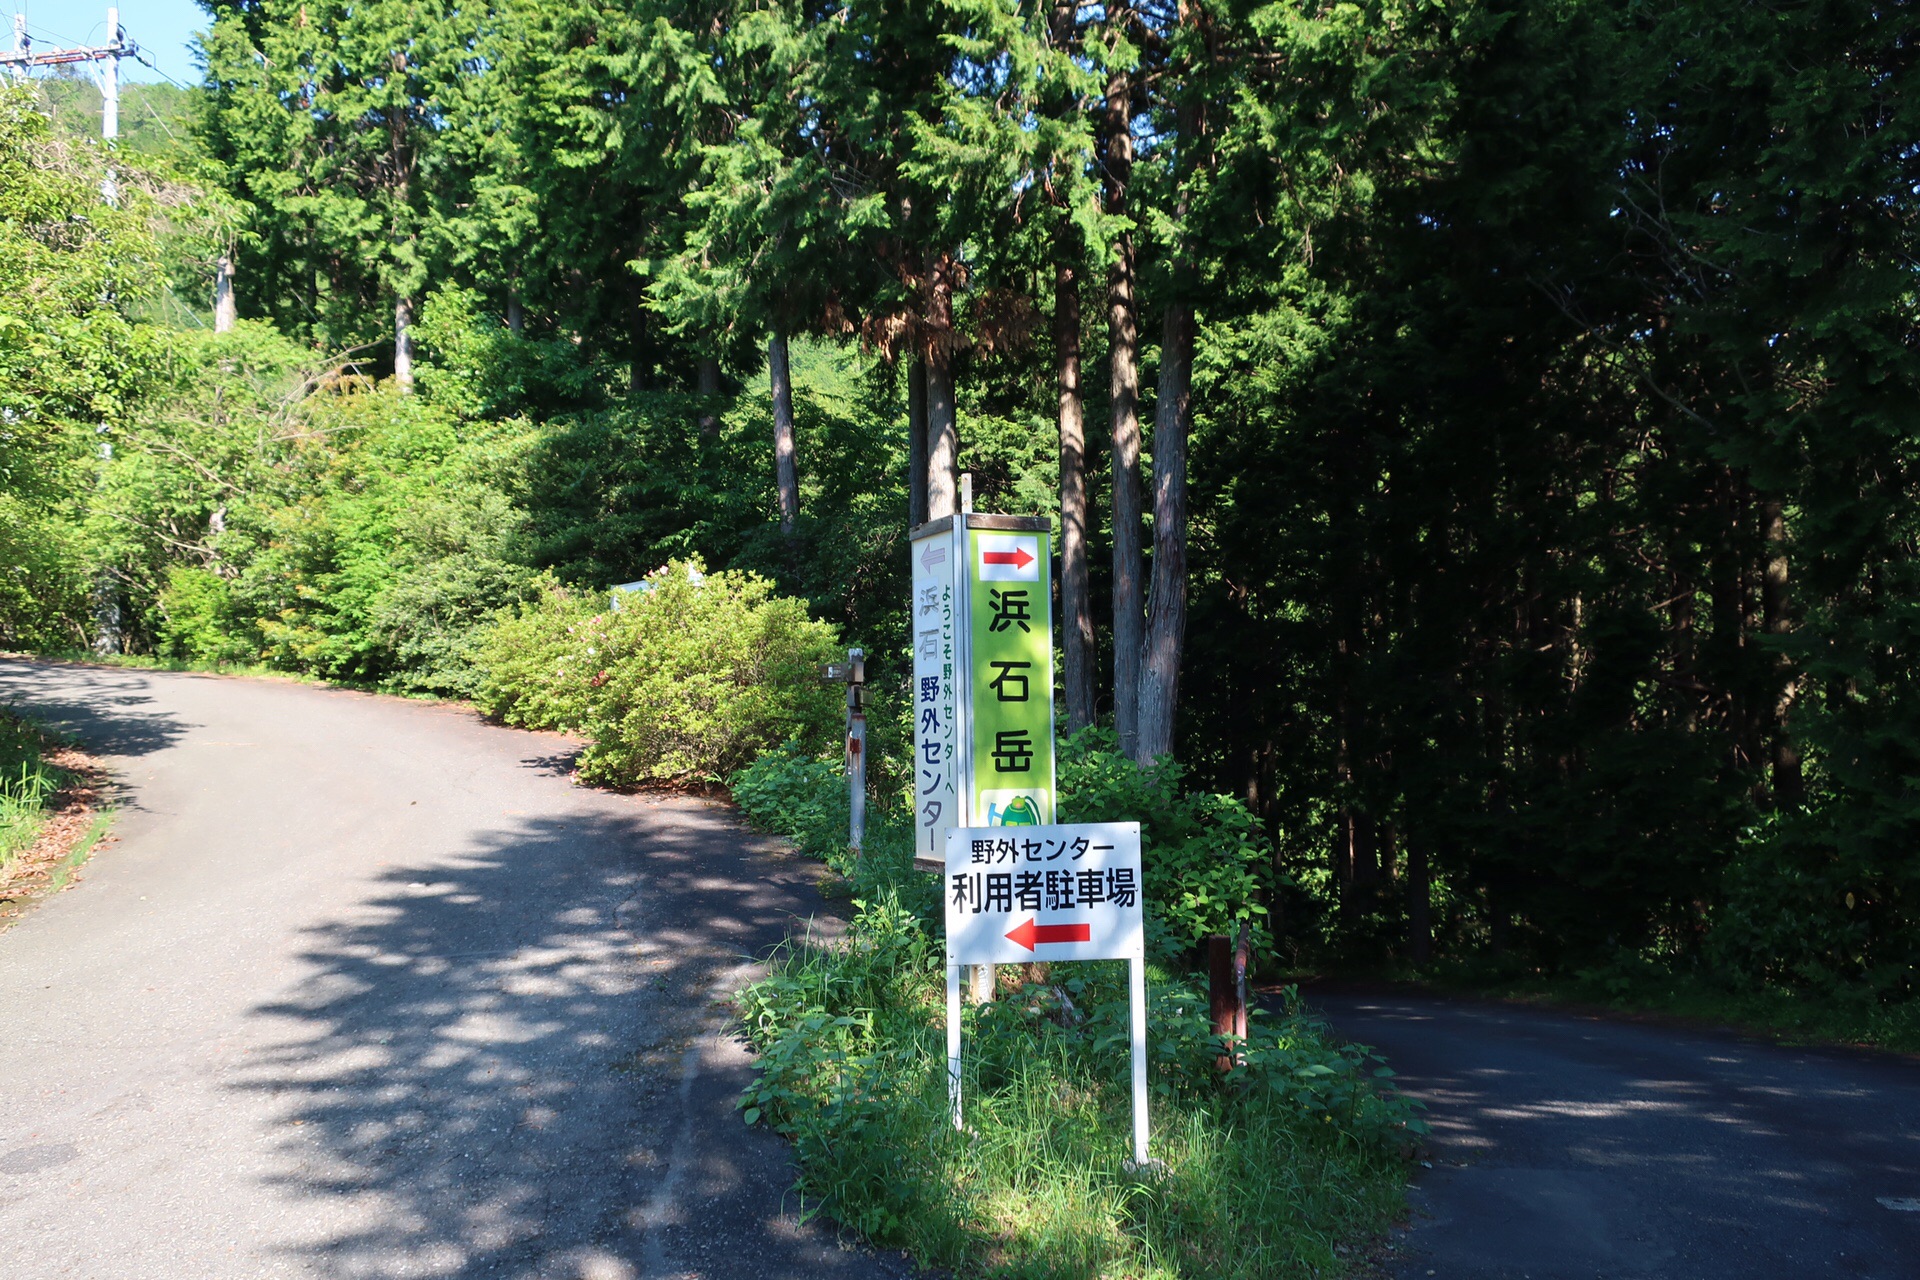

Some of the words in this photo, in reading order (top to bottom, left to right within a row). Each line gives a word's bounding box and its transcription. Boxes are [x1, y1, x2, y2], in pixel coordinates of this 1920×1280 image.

[942, 584, 955, 795] ようこそ野外センターへ
[988, 588, 1034, 772] 浜石岳
[952, 868, 1136, 914] 利用者駐車場
[971, 836, 1115, 864] 野外センター
